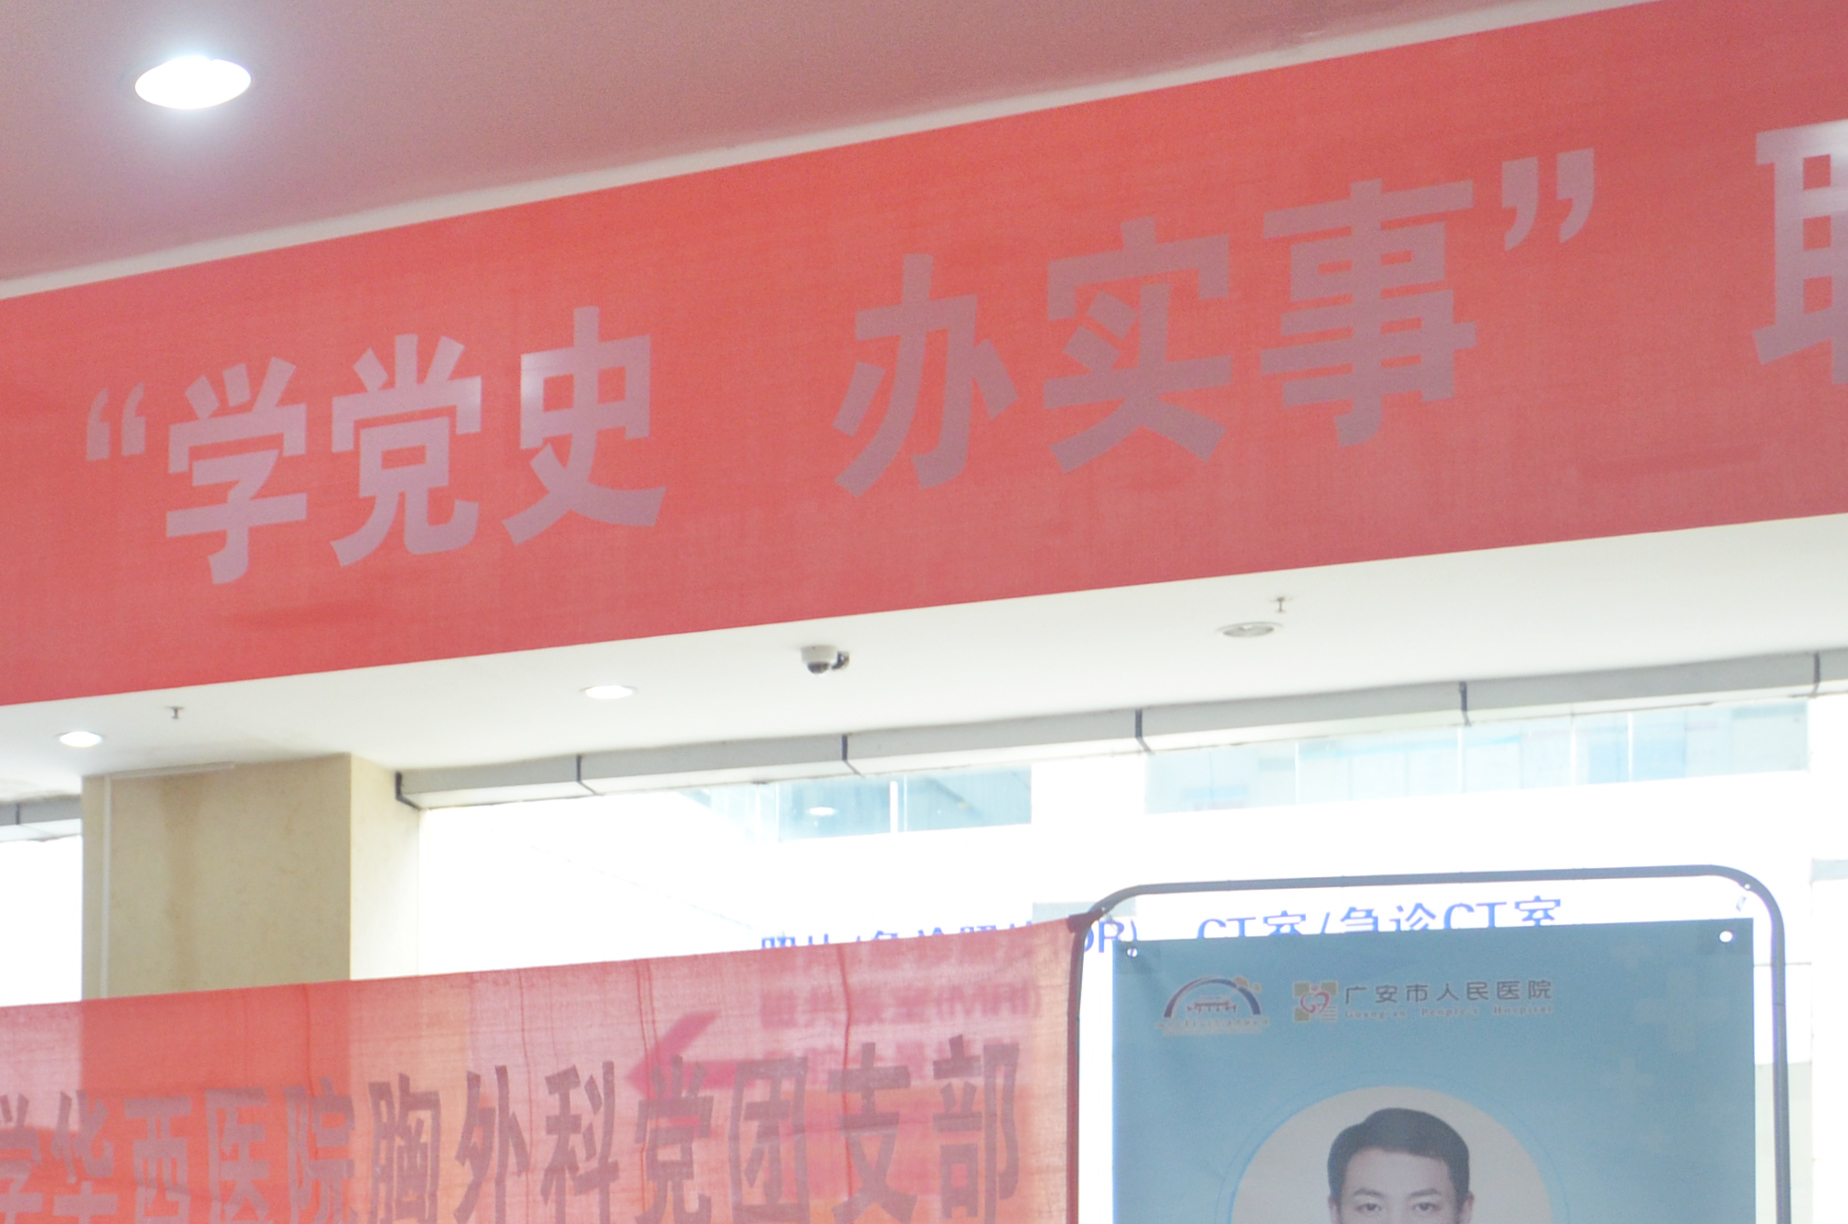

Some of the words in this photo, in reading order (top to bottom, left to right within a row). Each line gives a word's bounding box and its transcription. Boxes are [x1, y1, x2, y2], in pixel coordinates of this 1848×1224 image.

[84, 305, 667, 586] “学党史
[832, 147, 1596, 498] 办实事”
[1344, 979, 1553, 1005] 广安市人民医院
